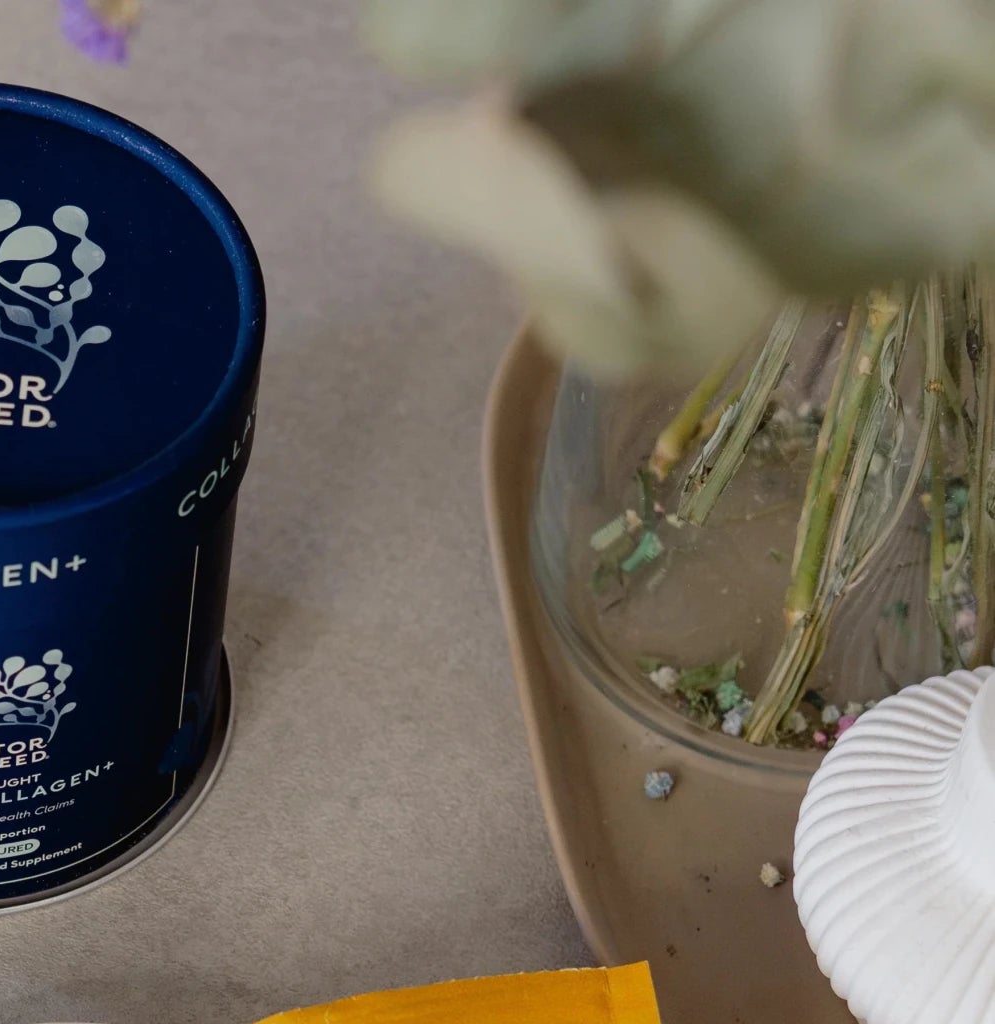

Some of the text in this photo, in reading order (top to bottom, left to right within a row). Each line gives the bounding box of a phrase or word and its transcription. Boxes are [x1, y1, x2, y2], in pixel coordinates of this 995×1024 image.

[178, 405, 255, 517] COLLA
[34, 798, 75, 816] Claims
[0, 824, 46, 841] portion
[10, 841, 83, 869] Supplement
